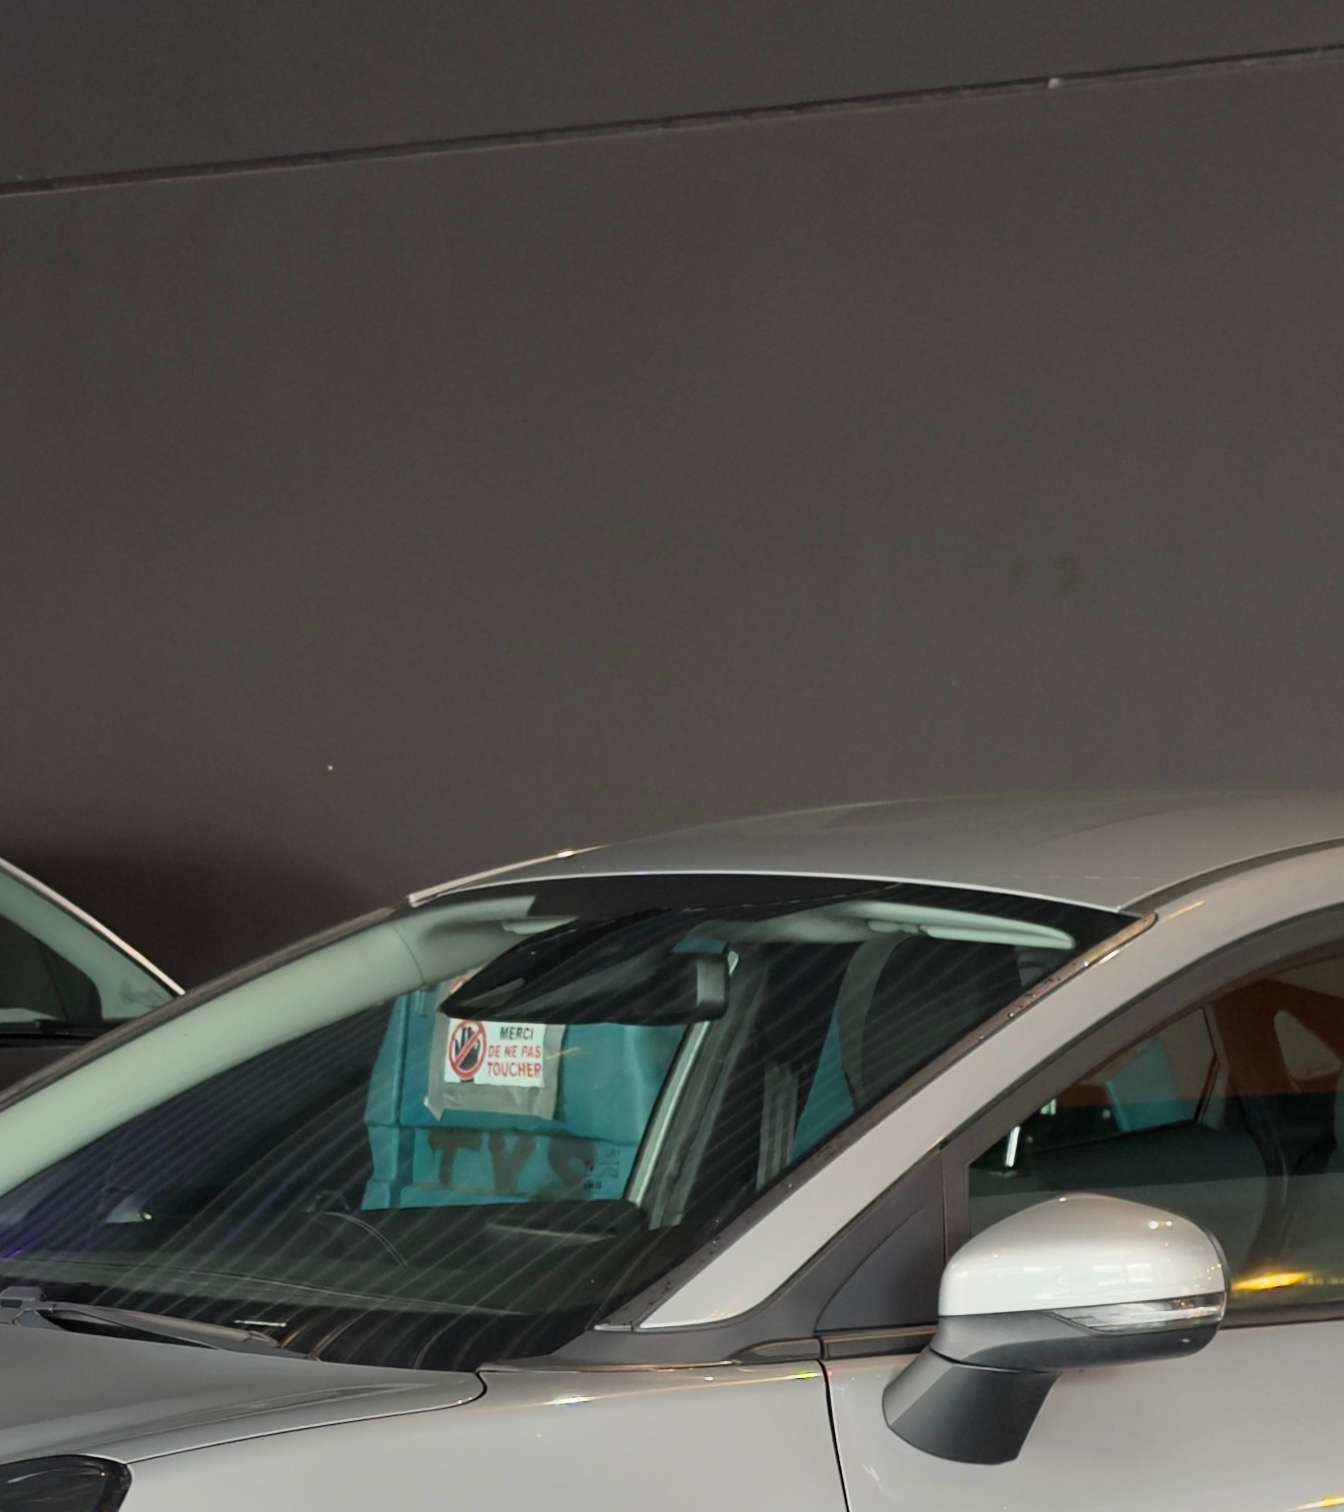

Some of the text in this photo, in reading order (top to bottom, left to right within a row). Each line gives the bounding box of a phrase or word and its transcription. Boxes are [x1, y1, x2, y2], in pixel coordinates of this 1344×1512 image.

[500, 1026, 534, 1041] MERCI
[488, 1045, 541, 1058] DE NE PAS
[487, 1062, 541, 1078] TOUCHER
